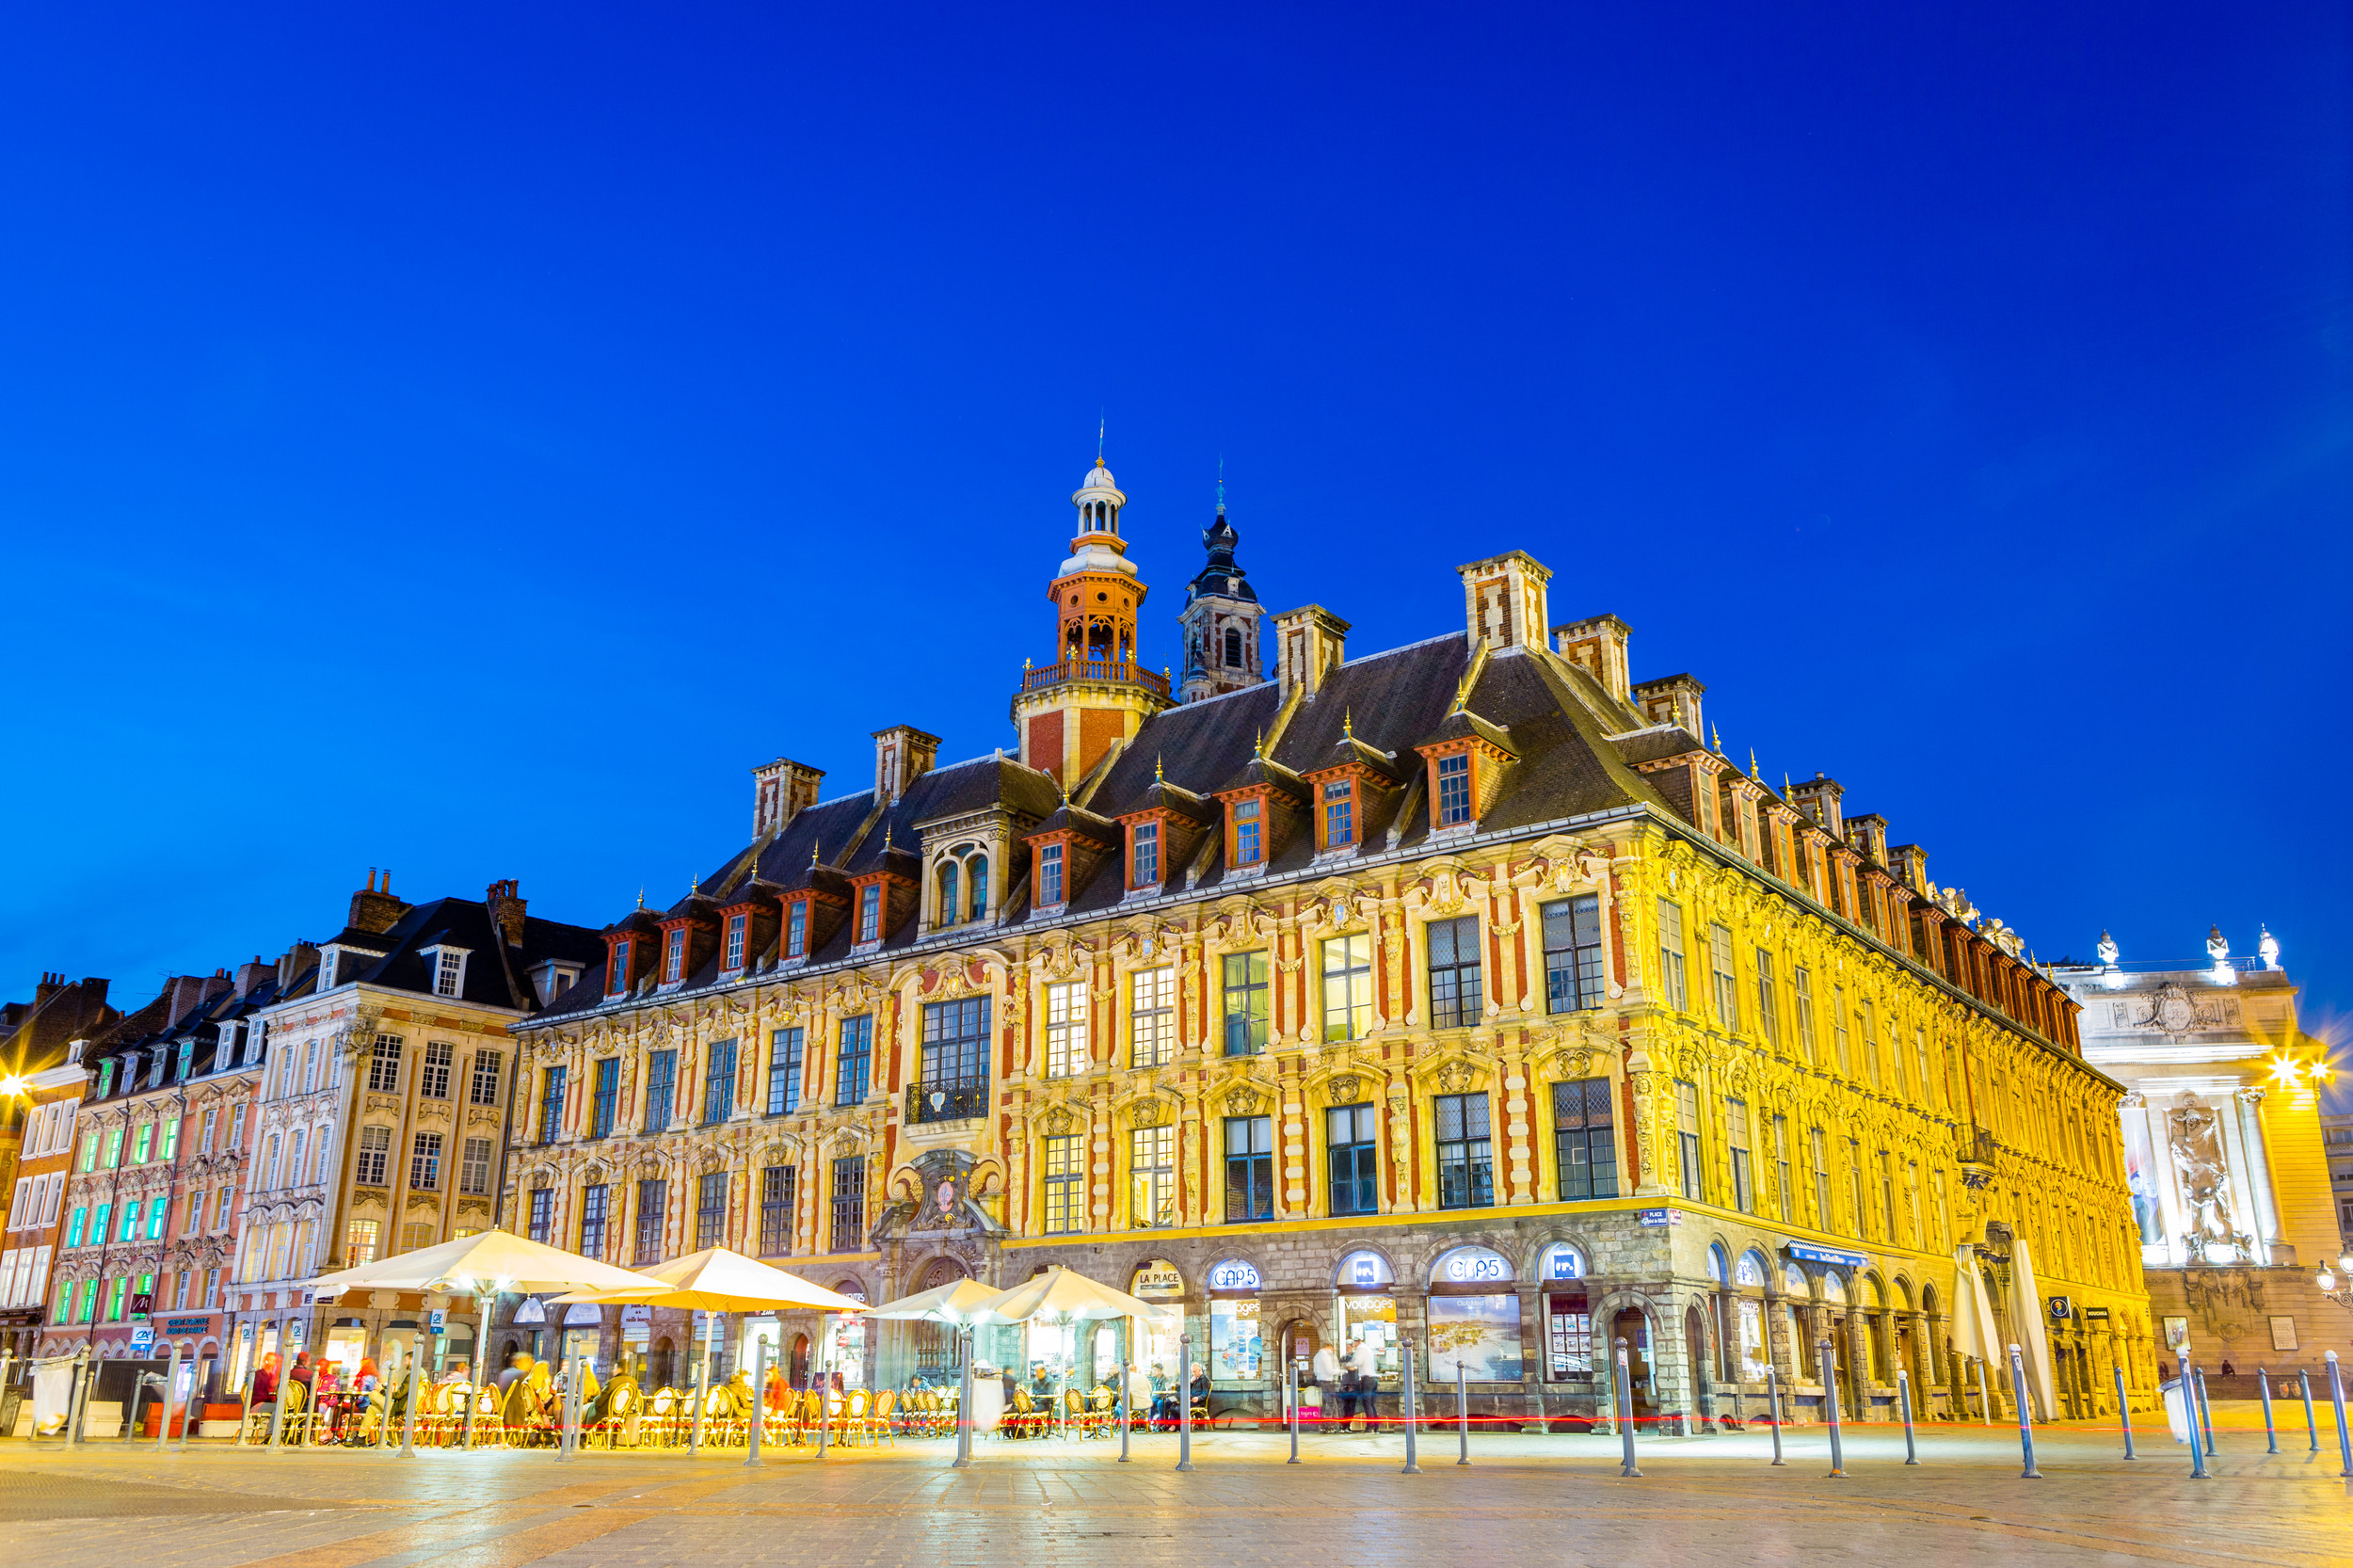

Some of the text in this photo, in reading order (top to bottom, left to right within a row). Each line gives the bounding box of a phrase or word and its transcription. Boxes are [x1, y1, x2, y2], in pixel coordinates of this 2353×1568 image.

[1140, 1272, 1179, 1283] LA PLACE
[1236, 1303, 1260, 1316] ages
[1344, 1299, 1394, 1312] voyages
